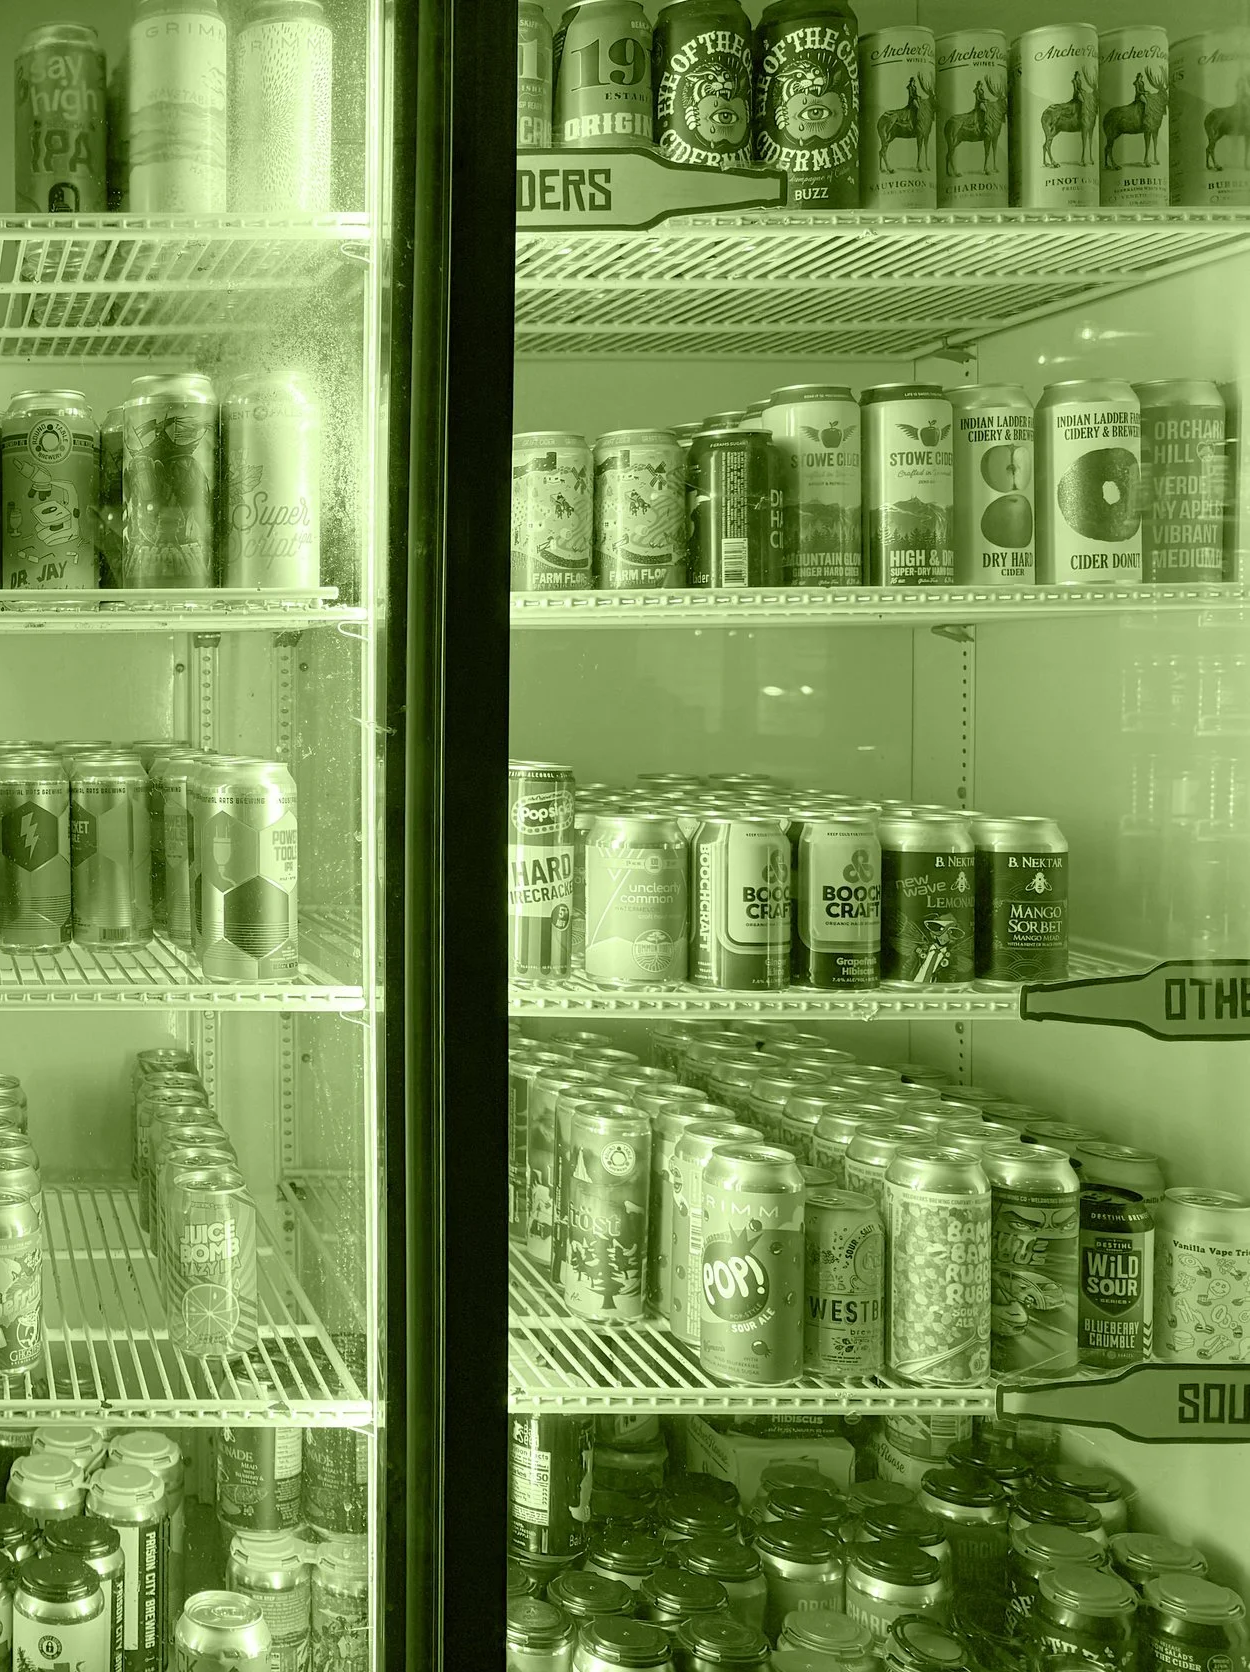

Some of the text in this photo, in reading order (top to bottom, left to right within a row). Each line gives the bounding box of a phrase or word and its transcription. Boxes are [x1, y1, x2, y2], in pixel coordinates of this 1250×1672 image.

[29, 55, 84, 85] say
[31, 87, 98, 120] high
[30, 131, 95, 174] IPA
[515, 168, 612, 211] DERS
[1045, 177, 1078, 187] PINOT
[794, 189, 829, 201] BUZZ
[959, 414, 1027, 430] INDIAN LADDER
[1057, 411, 1128, 428] INDIAN LADDER
[967, 428, 1012, 442] CIDERY &
[1064, 427, 1110, 440] CIDERY &
[890, 452, 932, 467] STOWE
[1154, 442, 1194, 463] HILL
[1152, 522, 1217, 545] VIBRANT
[890, 550, 940, 567] HIGH &
[982, 553, 1007, 567] DRY
[1071, 554, 1108, 570] CIDER
[36, 561, 68, 582] JAY
[533, 573, 562, 584] FARM
[890, 567, 931, 576] SUPER-DRY
[511, 853, 570, 887] HARD
[935, 857, 945, 868] B.
[1008, 856, 1063, 868] B. NEKTAR
[896, 875, 930, 888] new
[903, 881, 947, 898] wave
[620, 894, 674, 904] common
[699, 843, 710, 952] BOOCHCRAFT
[826, 902, 881, 918] CRAFT
[1009, 905, 1062, 919] MANGO
[1007, 920, 1063, 934] SORBET
[1090, 1213, 1125, 1222] DESTIHL
[179, 1219, 237, 1244] JUICE
[180, 1239, 240, 1263] BOMB
[845, 1238, 858, 1262] SOUR
[1096, 1241, 1131, 1249] DESTIHL
[1172, 1244, 1233, 1261] Vanilla Vape
[703, 1253, 767, 1305] POP!
[1087, 1279, 1138, 1298] SOUR
[731, 1307, 776, 1334] SOUR ALE
[1084, 1319, 1138, 1335] BLUEBERRY
[1089, 1334, 1135, 1350] CRUMBLE
[771, 1414, 824, 1430] Hibiscus
[145, 1531, 156, 1648] PRISON CITY BREWING
[1154, 1655, 1171, 1666] THE
